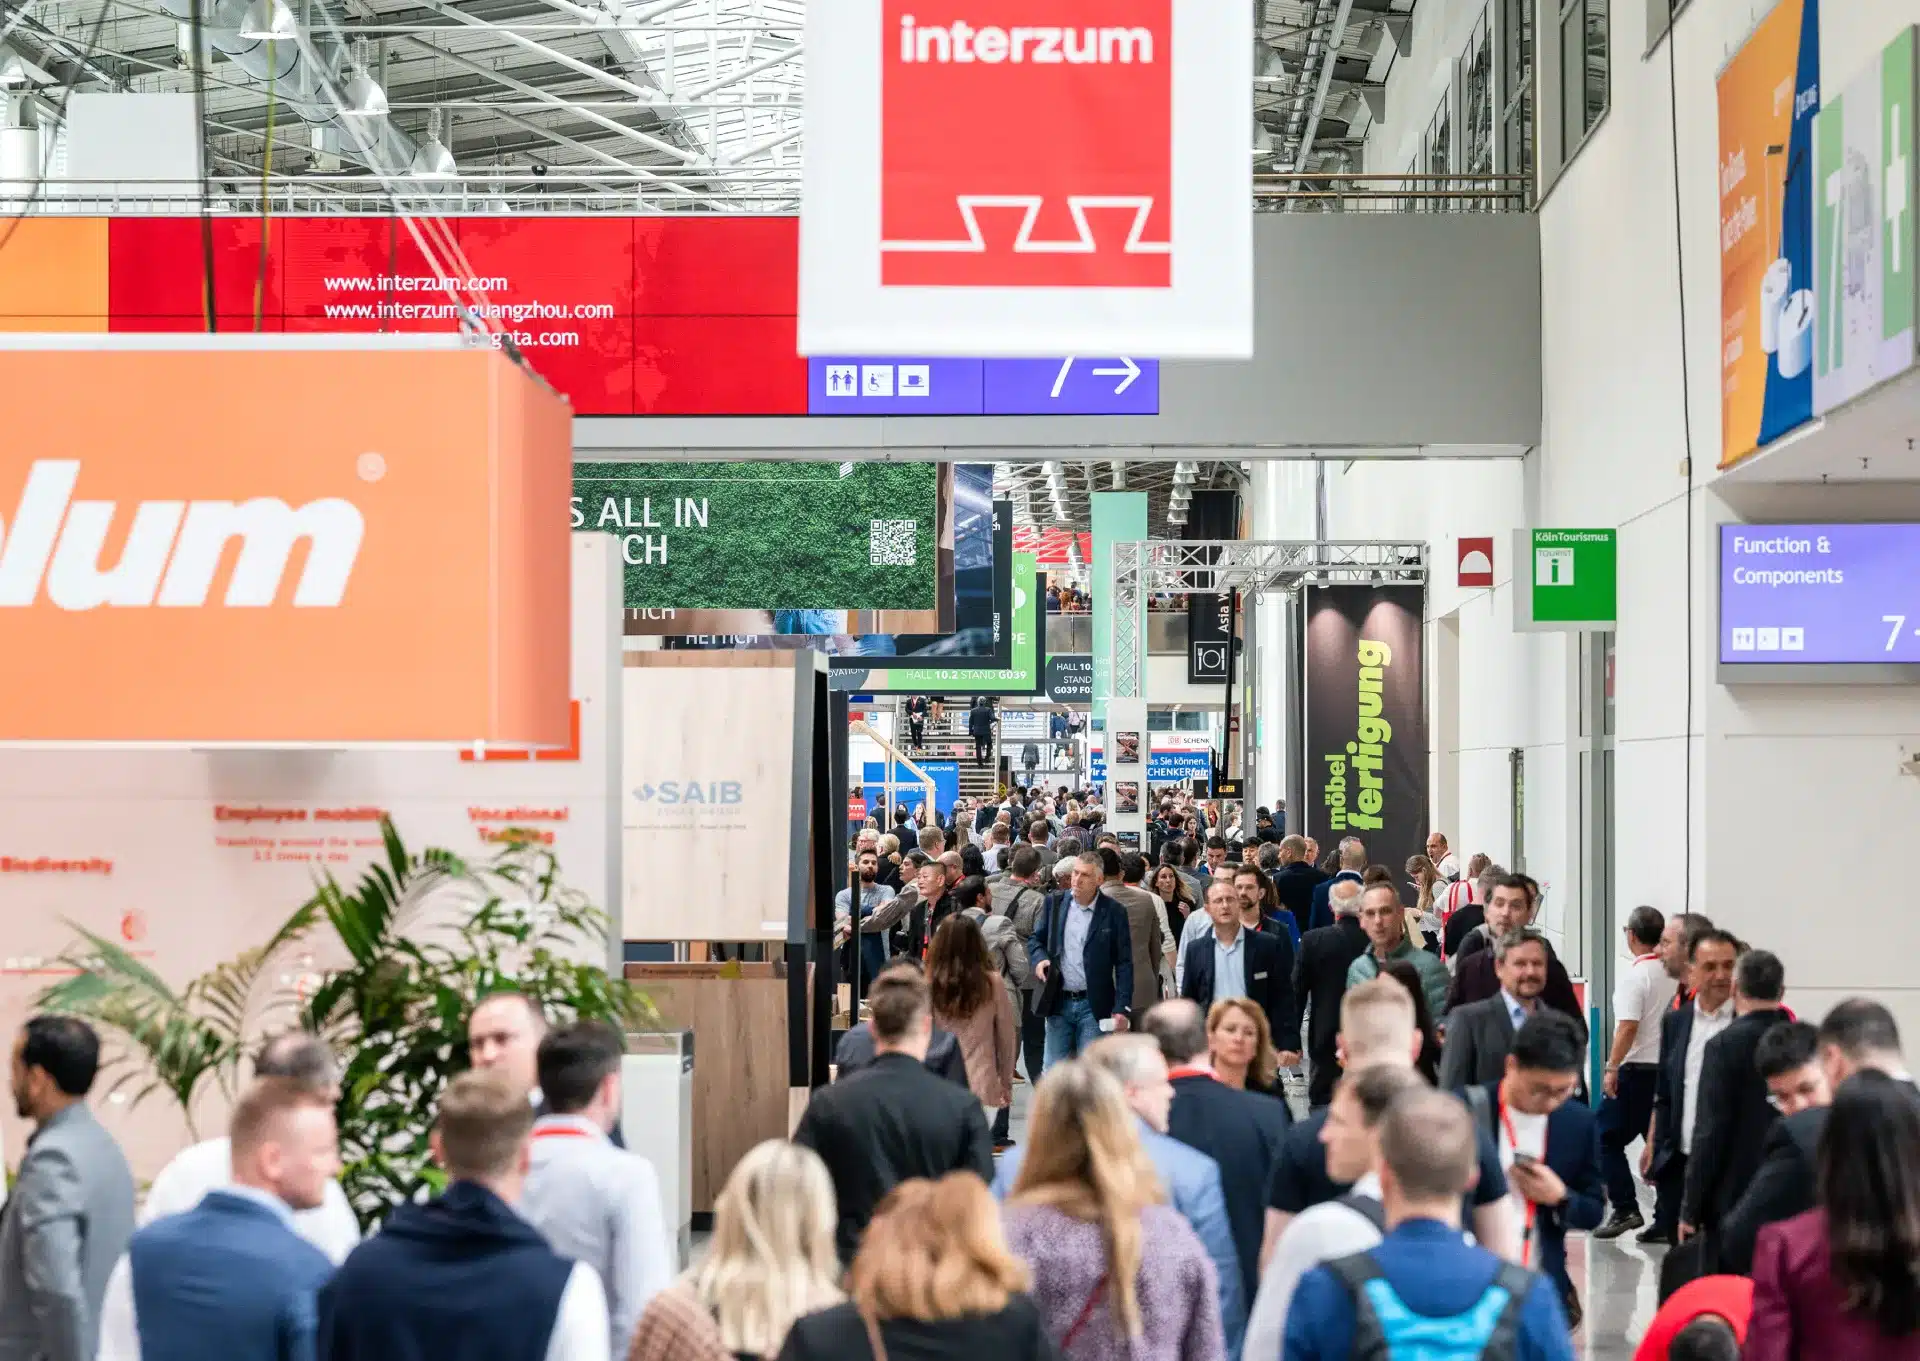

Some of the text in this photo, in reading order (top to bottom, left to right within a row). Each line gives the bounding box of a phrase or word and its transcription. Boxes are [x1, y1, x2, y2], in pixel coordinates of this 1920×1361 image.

[899, 15, 1153, 65] interzum
[324, 274, 508, 292] www.interzum.com
[324, 300, 614, 324] www.interzumguangzhou.com
[597, 497, 661, 528] ALL
[675, 497, 708, 528] IN
[0, 459, 365, 611] lum
[1734, 536, 1831, 554] Function &
[616, 533, 667, 565] CH
[1733, 567, 1843, 588] Components
[1217, 605, 1229, 633] Asia
[1881, 615, 1906, 651] 7
[905, 670, 1027, 680] HALL 10.2 STAND G039
[1056, 663, 1078, 671] HALL
[1054, 686, 1078, 694] G039
[1063, 675, 1092, 684] STAND
[1347, 639, 1392, 831] fertigung
[1160, 756, 1172, 765] Sie
[1174, 756, 1206, 765] können.
[658, 781, 742, 804] SAIB
[1325, 754, 1346, 830] möbel
